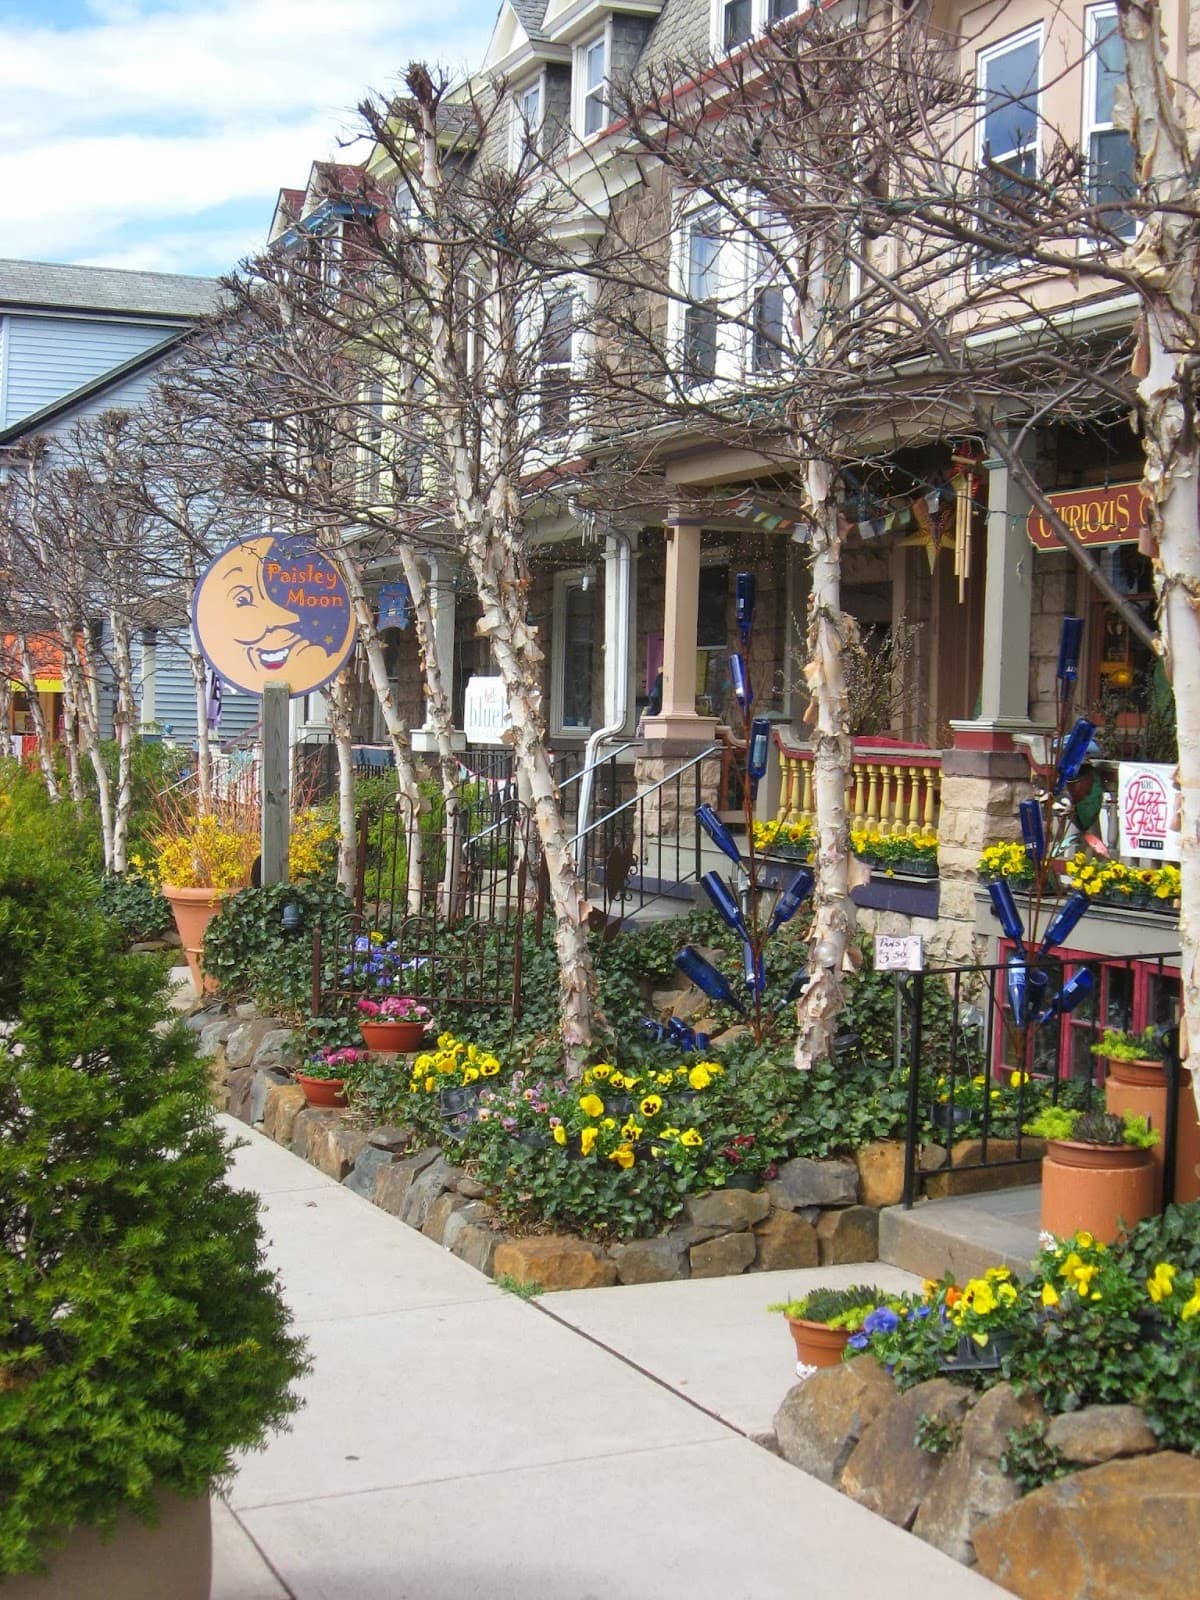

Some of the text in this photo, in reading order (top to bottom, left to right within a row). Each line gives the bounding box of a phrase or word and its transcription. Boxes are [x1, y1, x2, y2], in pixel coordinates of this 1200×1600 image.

[266, 563, 337, 590] Paisley
[285, 588, 344, 608] Moon
[1125, 780, 1167, 815] Jazz
